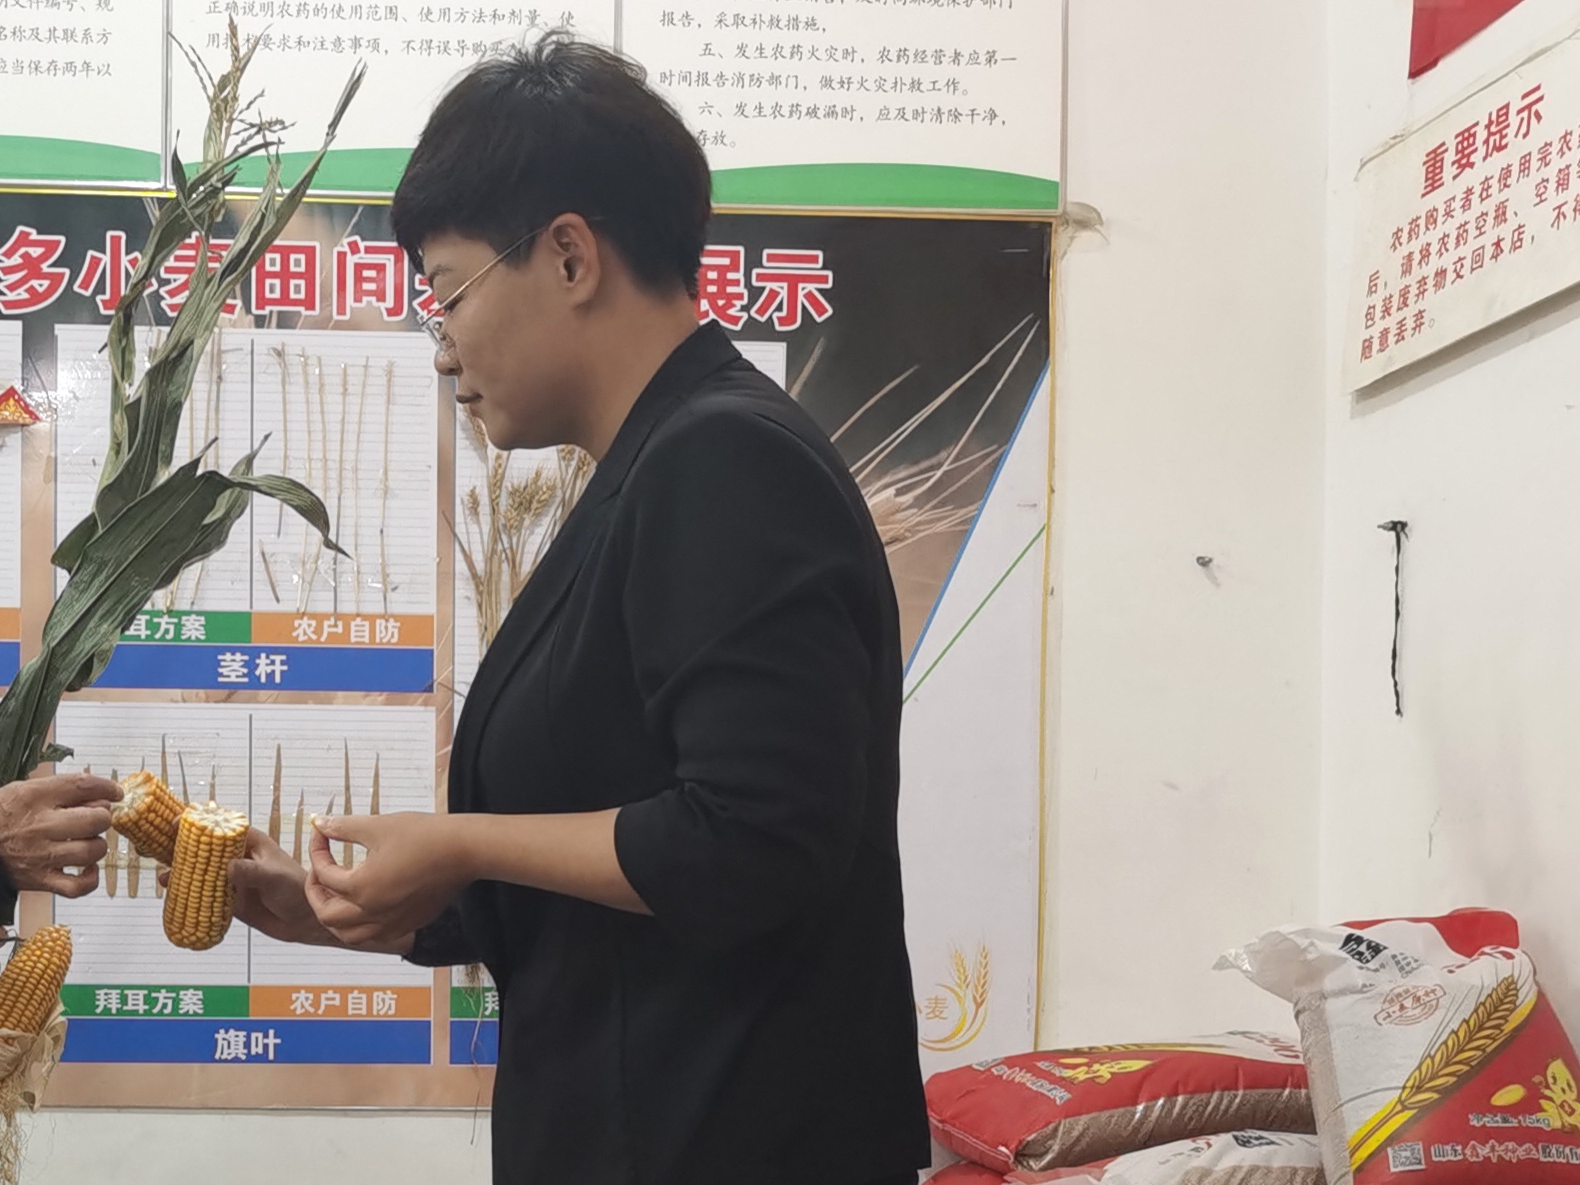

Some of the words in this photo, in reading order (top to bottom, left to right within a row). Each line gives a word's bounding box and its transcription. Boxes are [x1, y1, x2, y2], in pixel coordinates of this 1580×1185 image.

[698, 41, 1018, 68] 五、发生农药火灾时，农药经营者应第一
[659, 70, 970, 97] 时间报告消防部门，做好火灾扑救工作。
[1420, 83, 1546, 199] 重要提示
[1389, 124, 1580, 254] 农药购买者在使用完农
[1366, 158, 1580, 299] 后，请将农药空瓶、空箱
[1360, 308, 1436, 363] 随意丢弃。
[292, 616, 401, 643] 农户自防
[217, 652, 288, 684] 茎杆
[94, 989, 206, 1015] 拜耳方案
[290, 990, 398, 1016] 农户自防
[916, 996, 949, 1020] 麦
[214, 1028, 282, 1061] 旗叶
